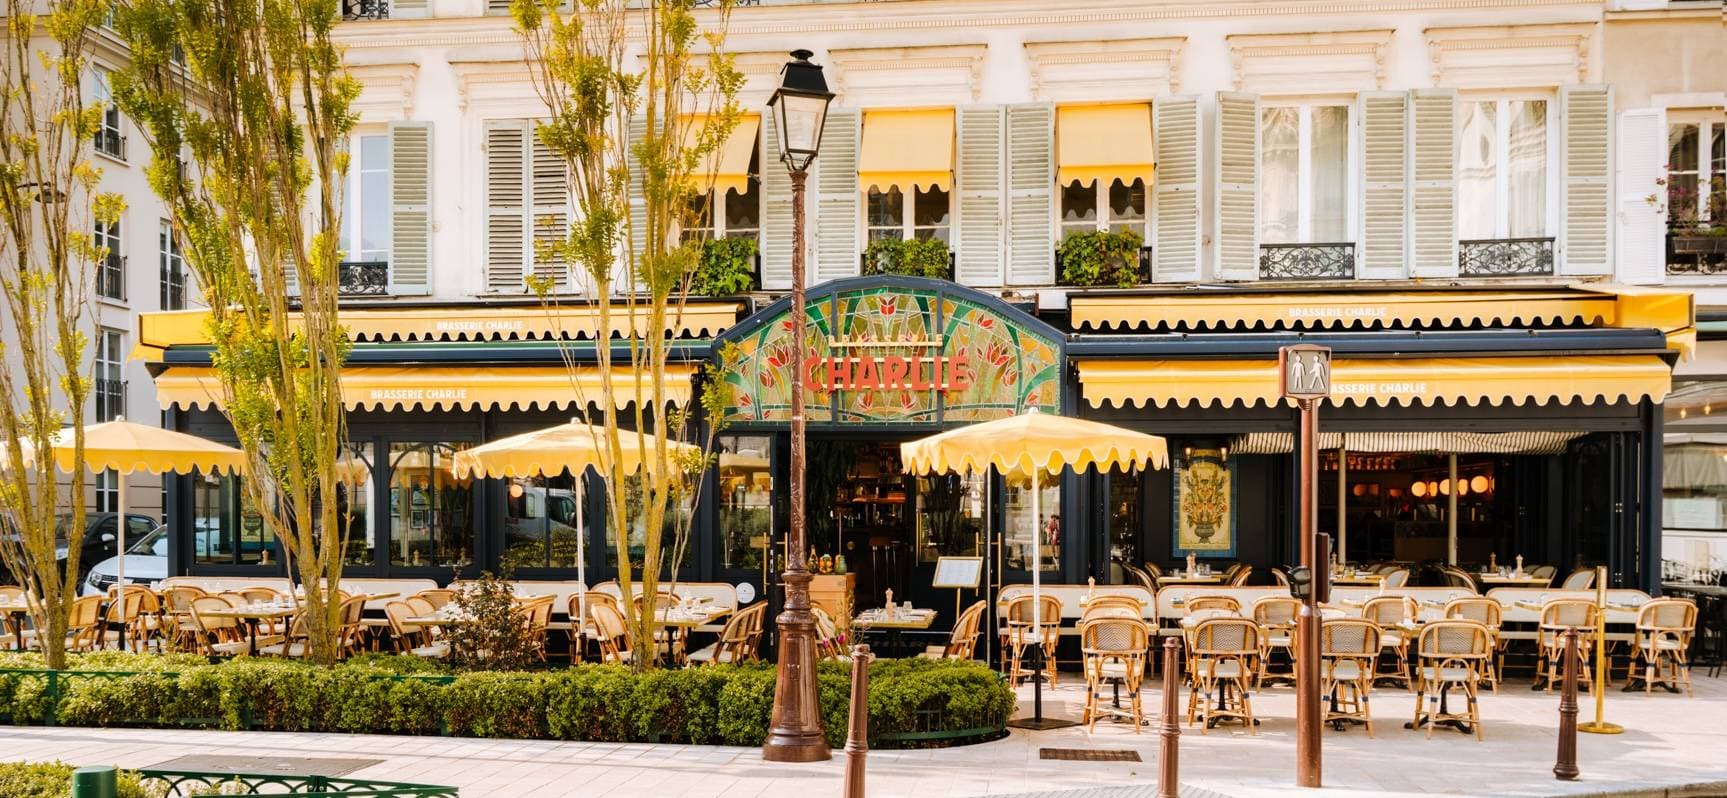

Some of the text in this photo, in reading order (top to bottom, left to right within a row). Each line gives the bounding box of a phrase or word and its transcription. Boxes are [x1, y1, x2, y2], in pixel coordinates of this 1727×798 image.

[1288, 307, 1387, 317] BRASSERIE CHARLIE
[437, 320, 523, 330] BRASSERIE CHARLIE
[803, 355, 970, 391] CHARLIE
[1331, 383, 1426, 394] ASSERIE CHARLIE
[371, 389, 467, 399] BRASSERIE CHARLIE
